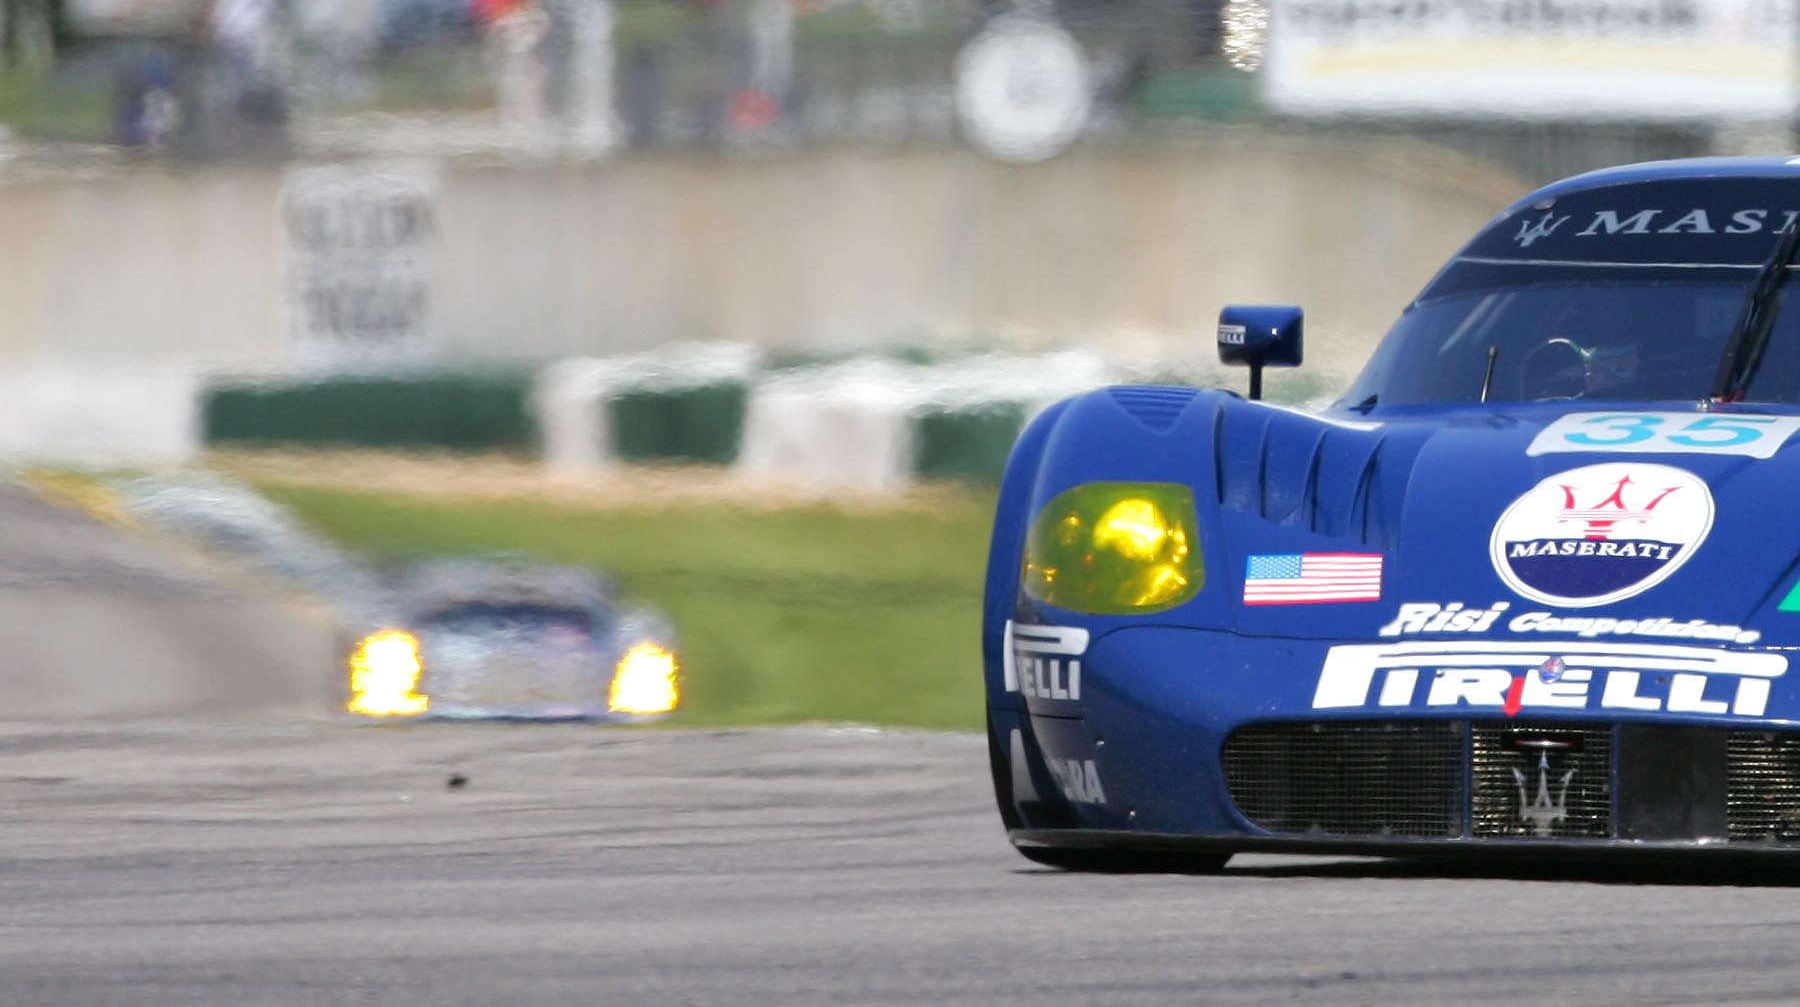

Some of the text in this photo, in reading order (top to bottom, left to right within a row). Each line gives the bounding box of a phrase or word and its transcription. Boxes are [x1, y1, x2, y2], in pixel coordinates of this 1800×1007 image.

[1563, 415, 1777, 447] 35
[1510, 540, 1673, 560] MASERATI
[1379, 602, 1510, 637] Risi
[1312, 640, 1790, 717] PIRELLI
